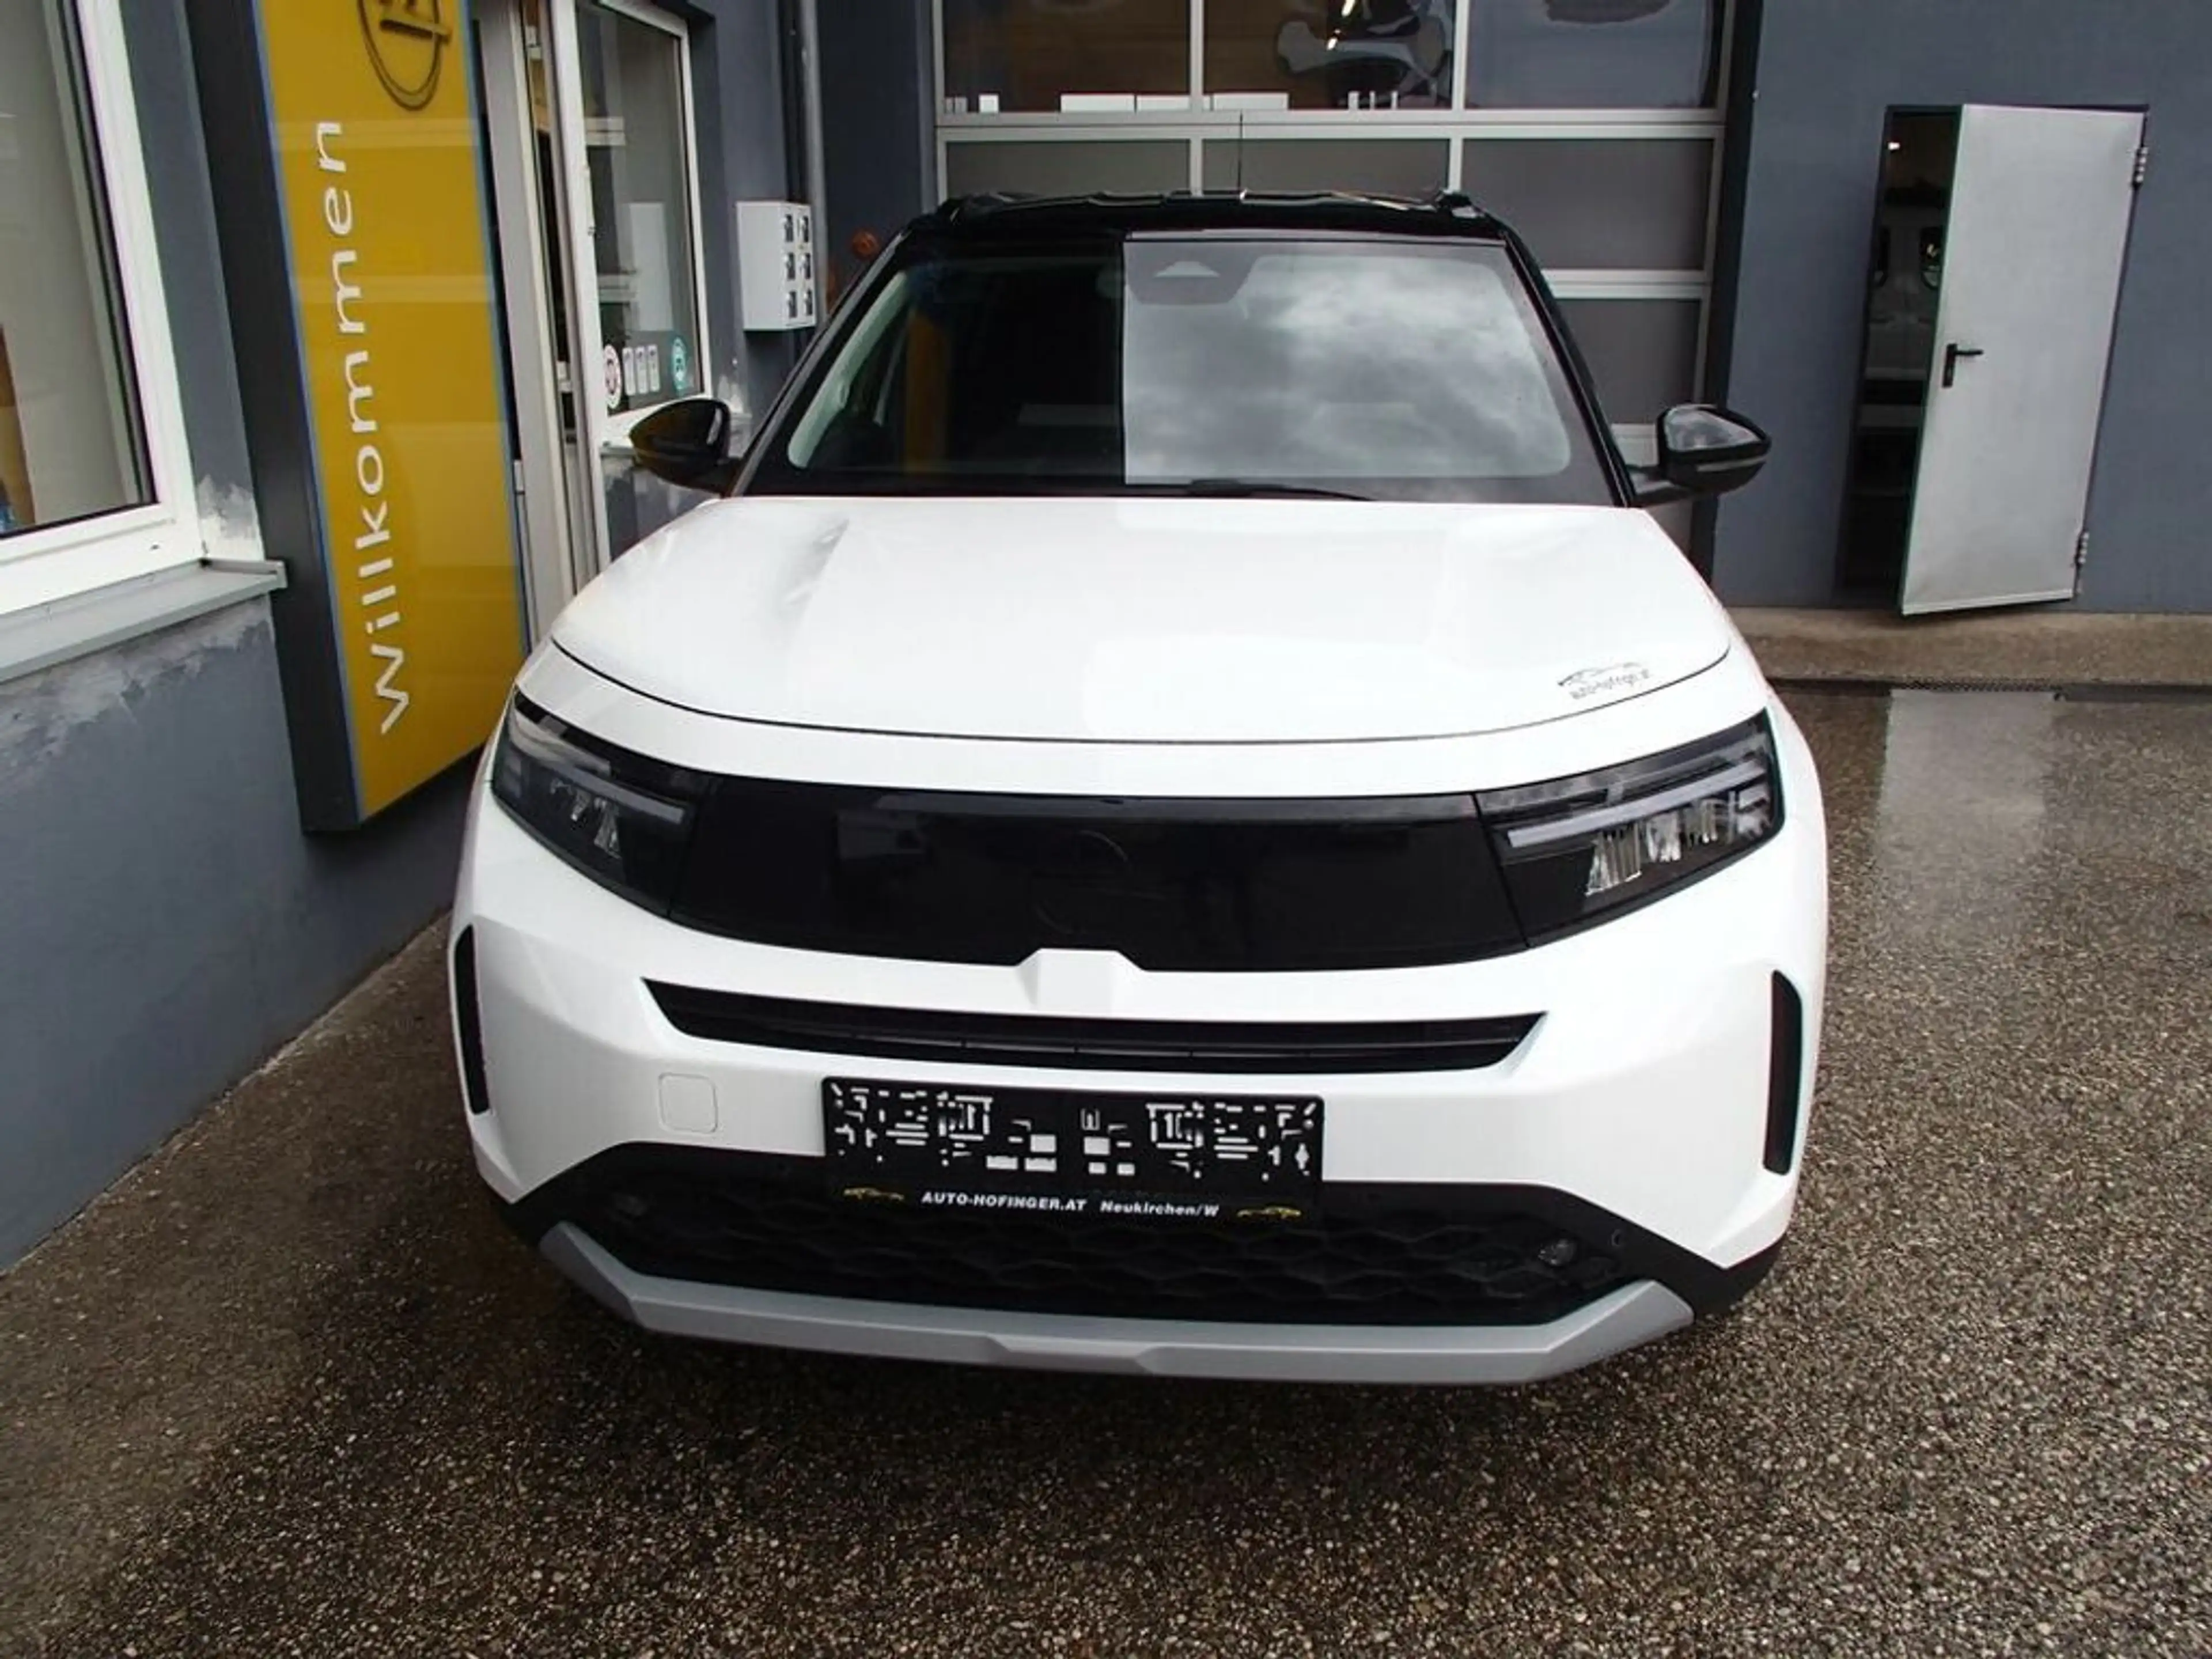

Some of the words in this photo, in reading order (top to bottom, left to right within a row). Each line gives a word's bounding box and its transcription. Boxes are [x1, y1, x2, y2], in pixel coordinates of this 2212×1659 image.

[317, 122, 409, 734] Willkommen
[921, 1191, 1087, 1211] AUTO-HOFINGER.AT
[1100, 1200, 1219, 1217] Neukirchen/W
